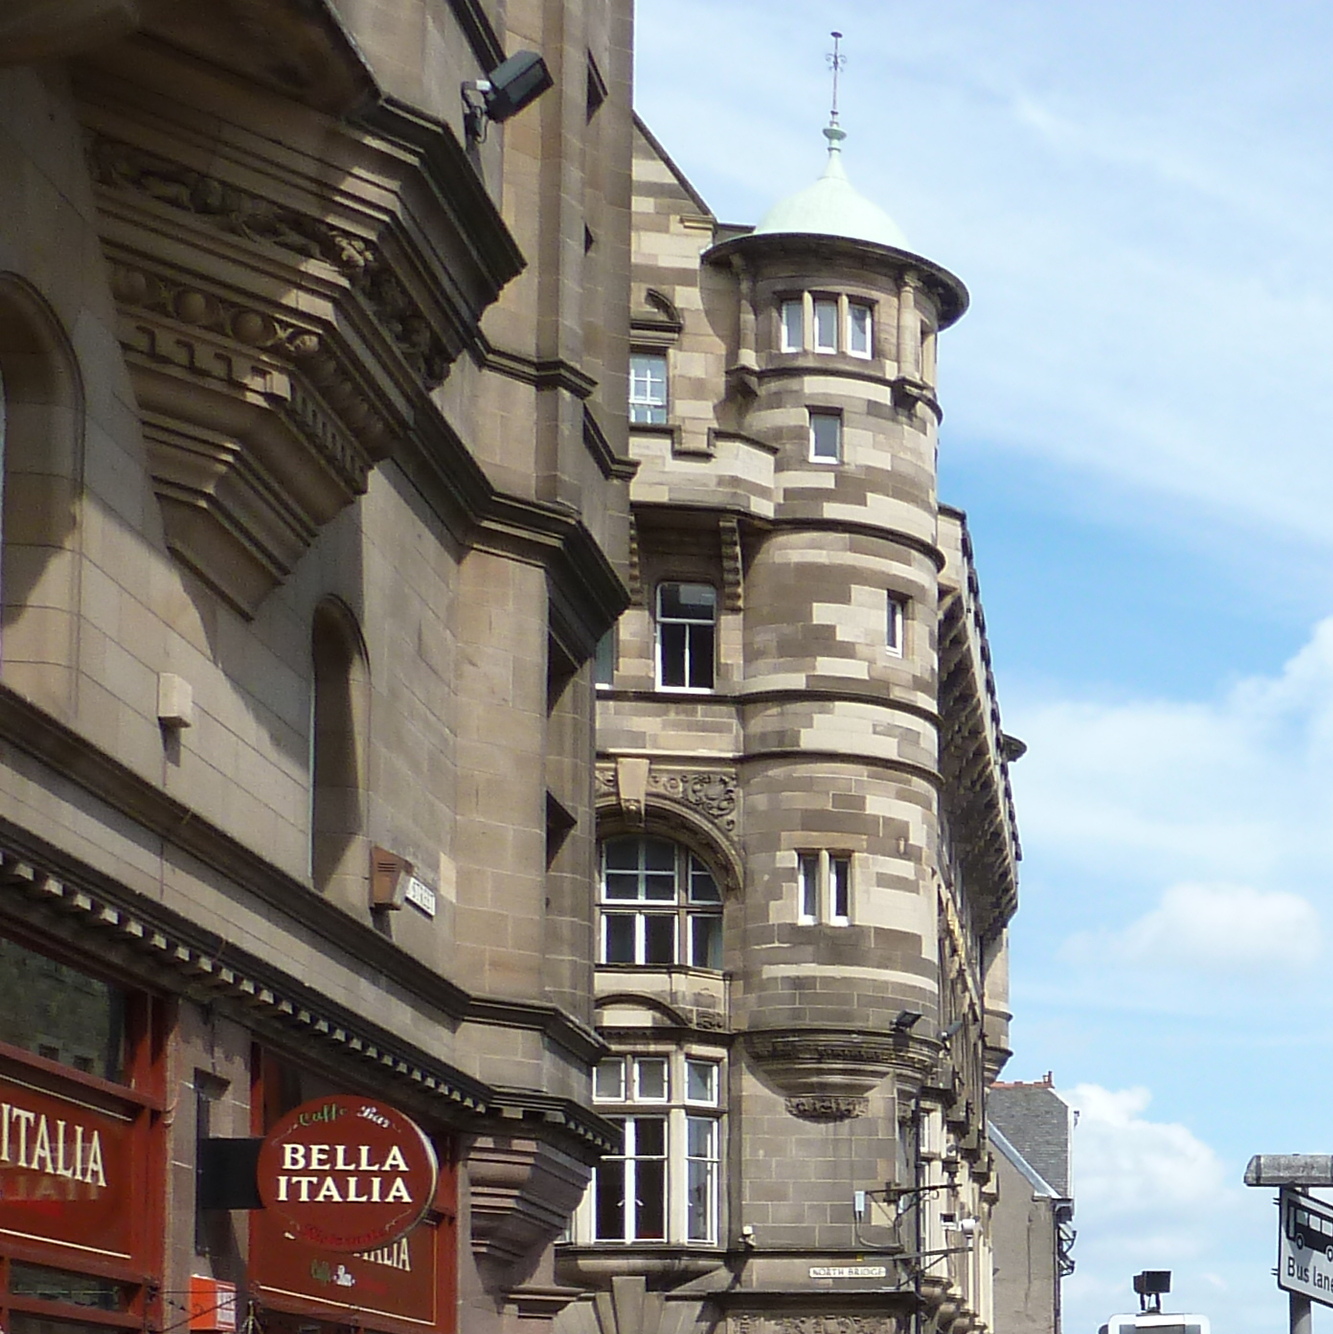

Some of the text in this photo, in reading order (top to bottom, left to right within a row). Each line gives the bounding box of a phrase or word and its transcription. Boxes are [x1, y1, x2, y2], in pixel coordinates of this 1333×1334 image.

[0, 1102, 107, 1187] ITALIA
[282, 1143, 410, 1171] BELLA
[277, 1175, 413, 1203] ITALIA
[812, 1267, 885, 1276] NORTH BRIDGE
[1287, 1256, 1310, 1284] Bus
